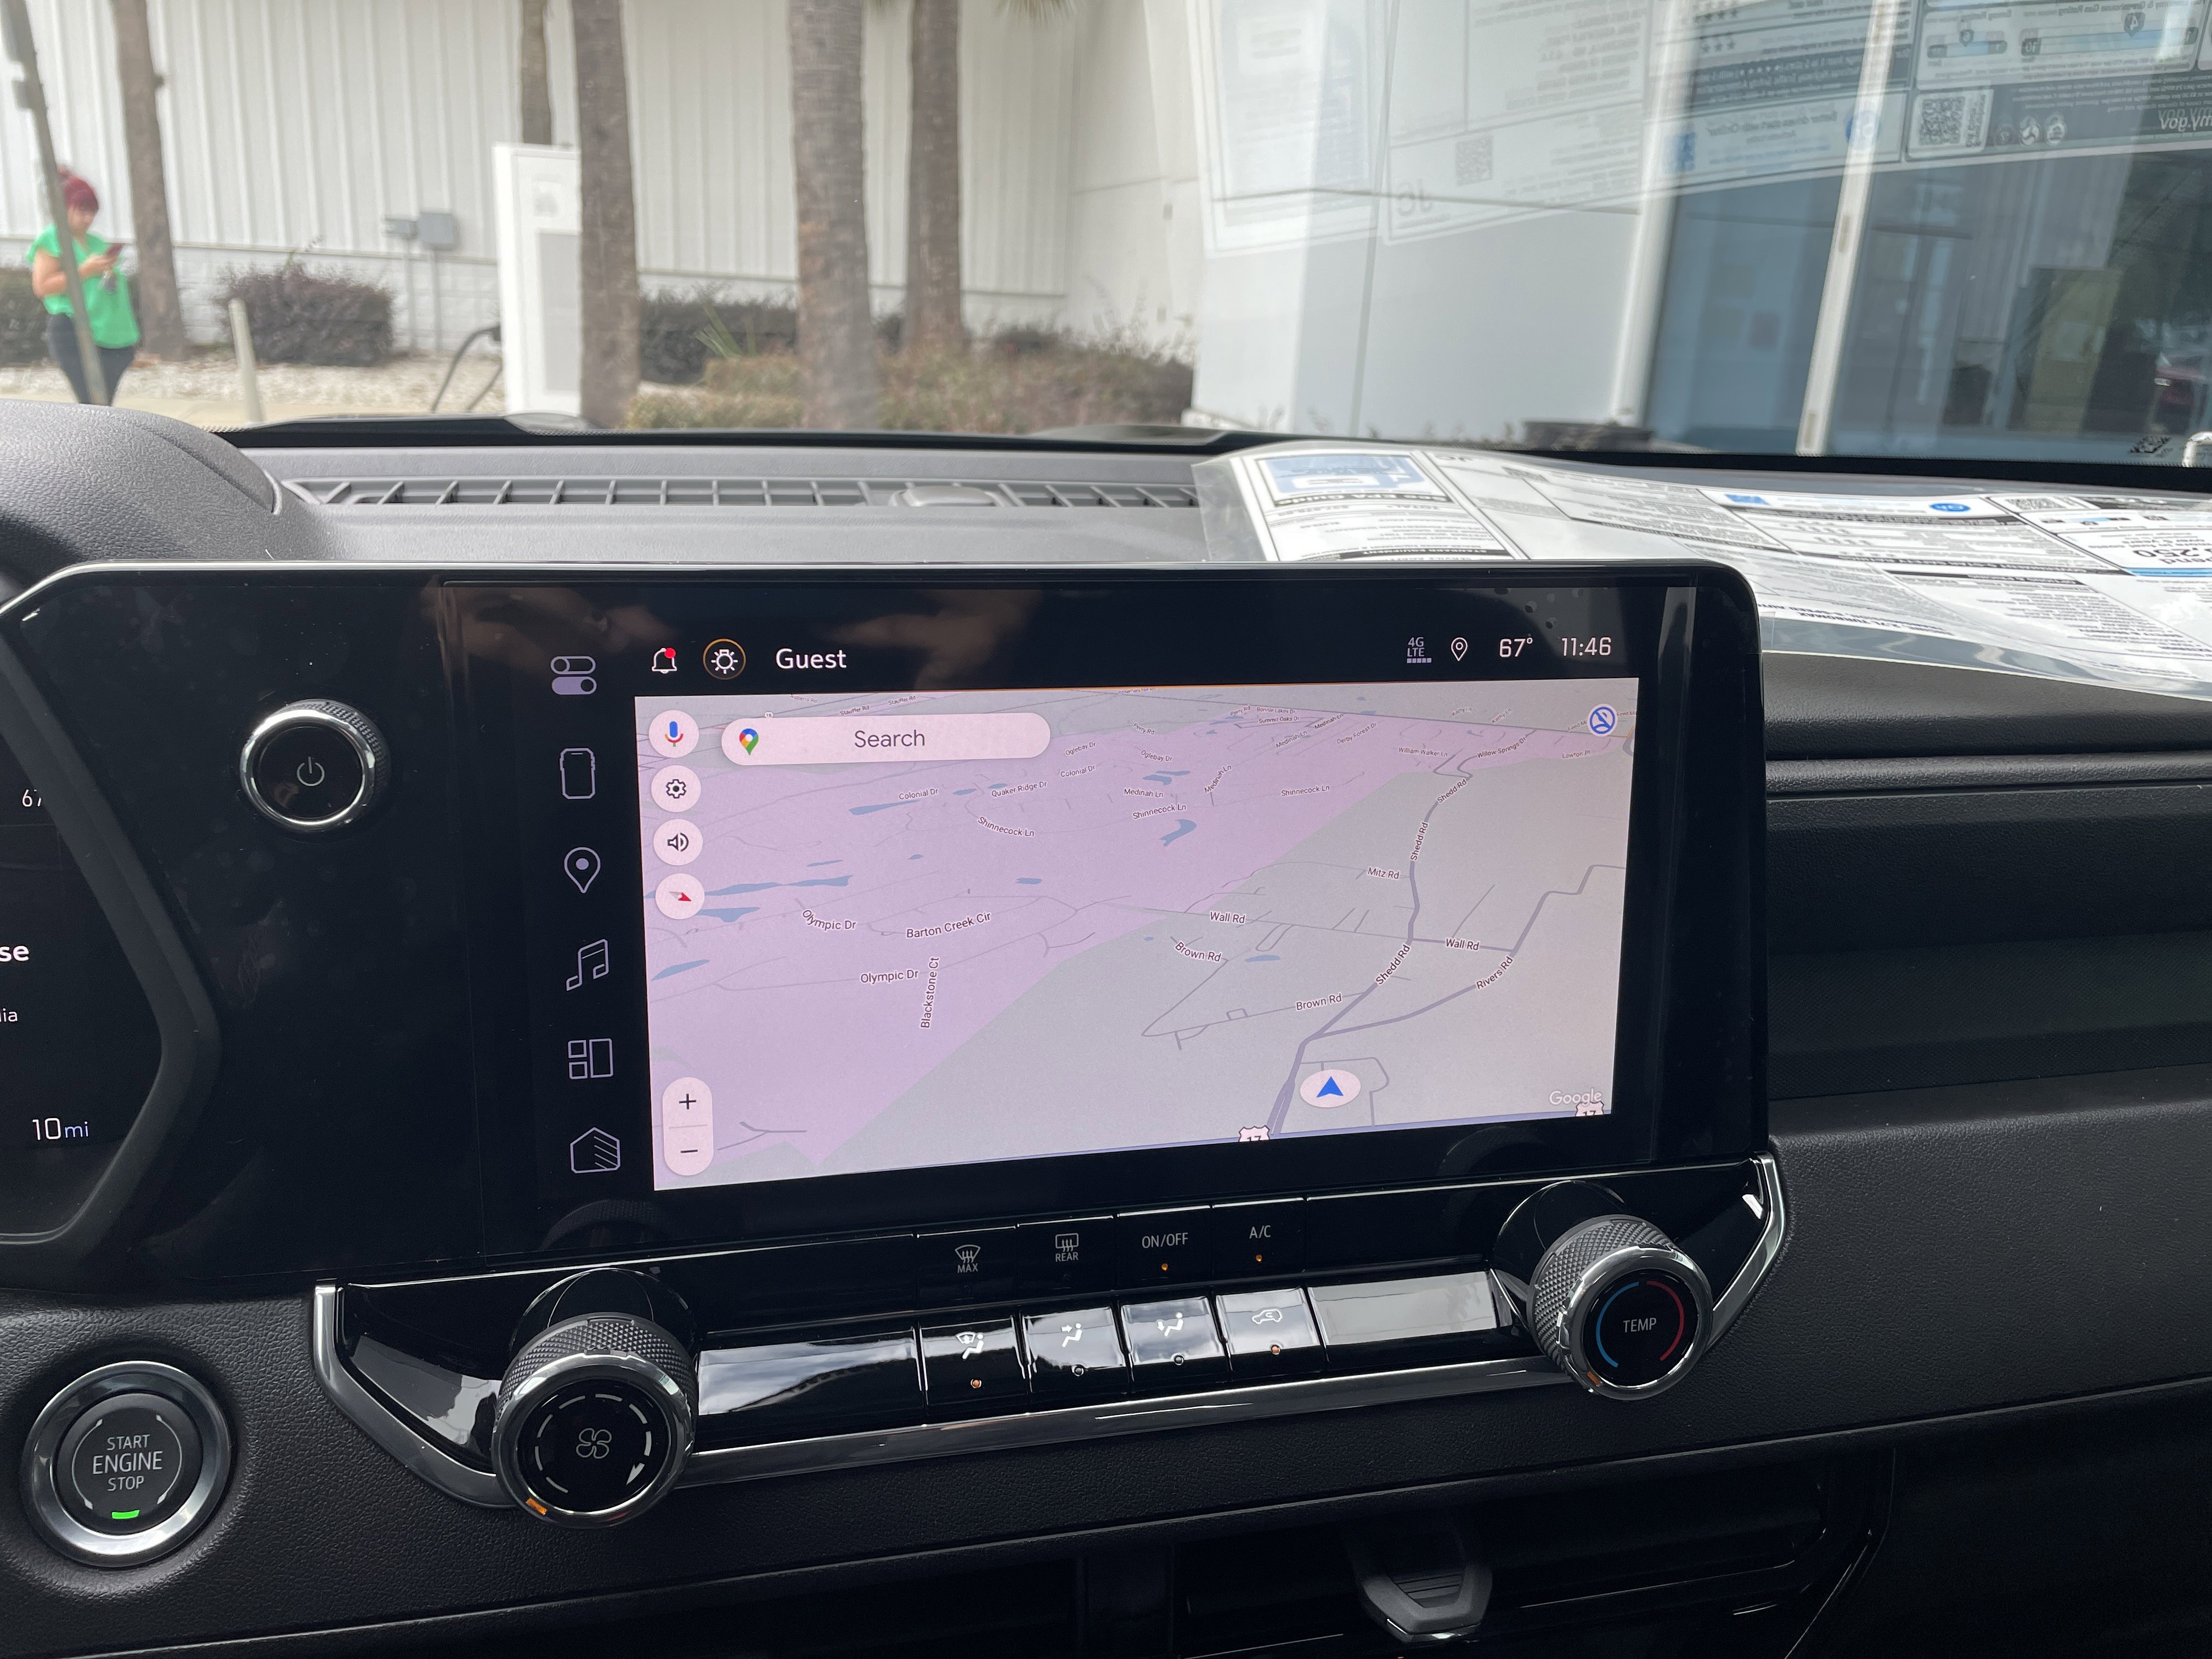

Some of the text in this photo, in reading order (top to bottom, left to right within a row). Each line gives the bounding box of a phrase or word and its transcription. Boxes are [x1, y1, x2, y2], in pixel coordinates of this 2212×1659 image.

[1408, 637, 1424, 647] 4G
[1561, 636, 1612, 656] 11:46
[776, 648, 847, 669] Guest
[1407, 647, 1425, 657] LTE
[1133, 723, 1146, 734] Perry
[1337, 736, 1352, 744] Derby
[1353, 726, 1370, 738] Forest
[854, 730, 926, 748] Search
[1276, 733, 1300, 748] Medinah
[1477, 736, 1526, 758] Willow Springs Dr
[1065, 744, 1088, 756] Oglebay
[1141, 749, 1164, 763] Oglebay
[1060, 768, 1087, 778] Colonial
[1204, 770, 1224, 793] Medinah
[899, 790, 929, 800] Colonial
[991, 787, 1017, 798] Quaker
[1017, 783, 1038, 793] Ridge
[1124, 789, 1154, 797] Medinah
[1282, 785, 1330, 797] Shinnecock Ln
[1437, 778, 1467, 804] Shedd Rd
[1133, 804, 1176, 820] Shinnecock
[978, 816, 1035, 837] Shinnecock Ln
[1410, 822, 1429, 861] Shedd Rd
[1368, 867, 1400, 880] Mitz Rd
[803, 909, 856, 931] Olympic Dr
[907, 912, 991, 938] Barton Creek Cir
[1210, 912, 1245, 924] Wall Rd
[1175, 941, 1222, 962] Brown Rd
[1446, 939, 1480, 951] Wall Rd
[1375, 944, 1410, 985] Shedd Rd
[861, 969, 919, 984] Olympic Dr
[1476, 956, 1514, 990] Rivers Rd
[921, 957, 939, 1029] Blackstone Ct
[1296, 994, 1342, 1011] Brown Rd
[1549, 1088, 1602, 1107] Google
[1142, 1232, 1188, 1248] ON/OFF
[1250, 1225, 1271, 1239] A/C
[1056, 1251, 1079, 1262] REAR
[957, 1263, 979, 1273] MAX
[1623, 1318, 1657, 1333] TEMP
[106, 1434, 150, 1451] START
[92, 1451, 163, 1475] ENGINE
[107, 1476, 144, 1492] STOP
